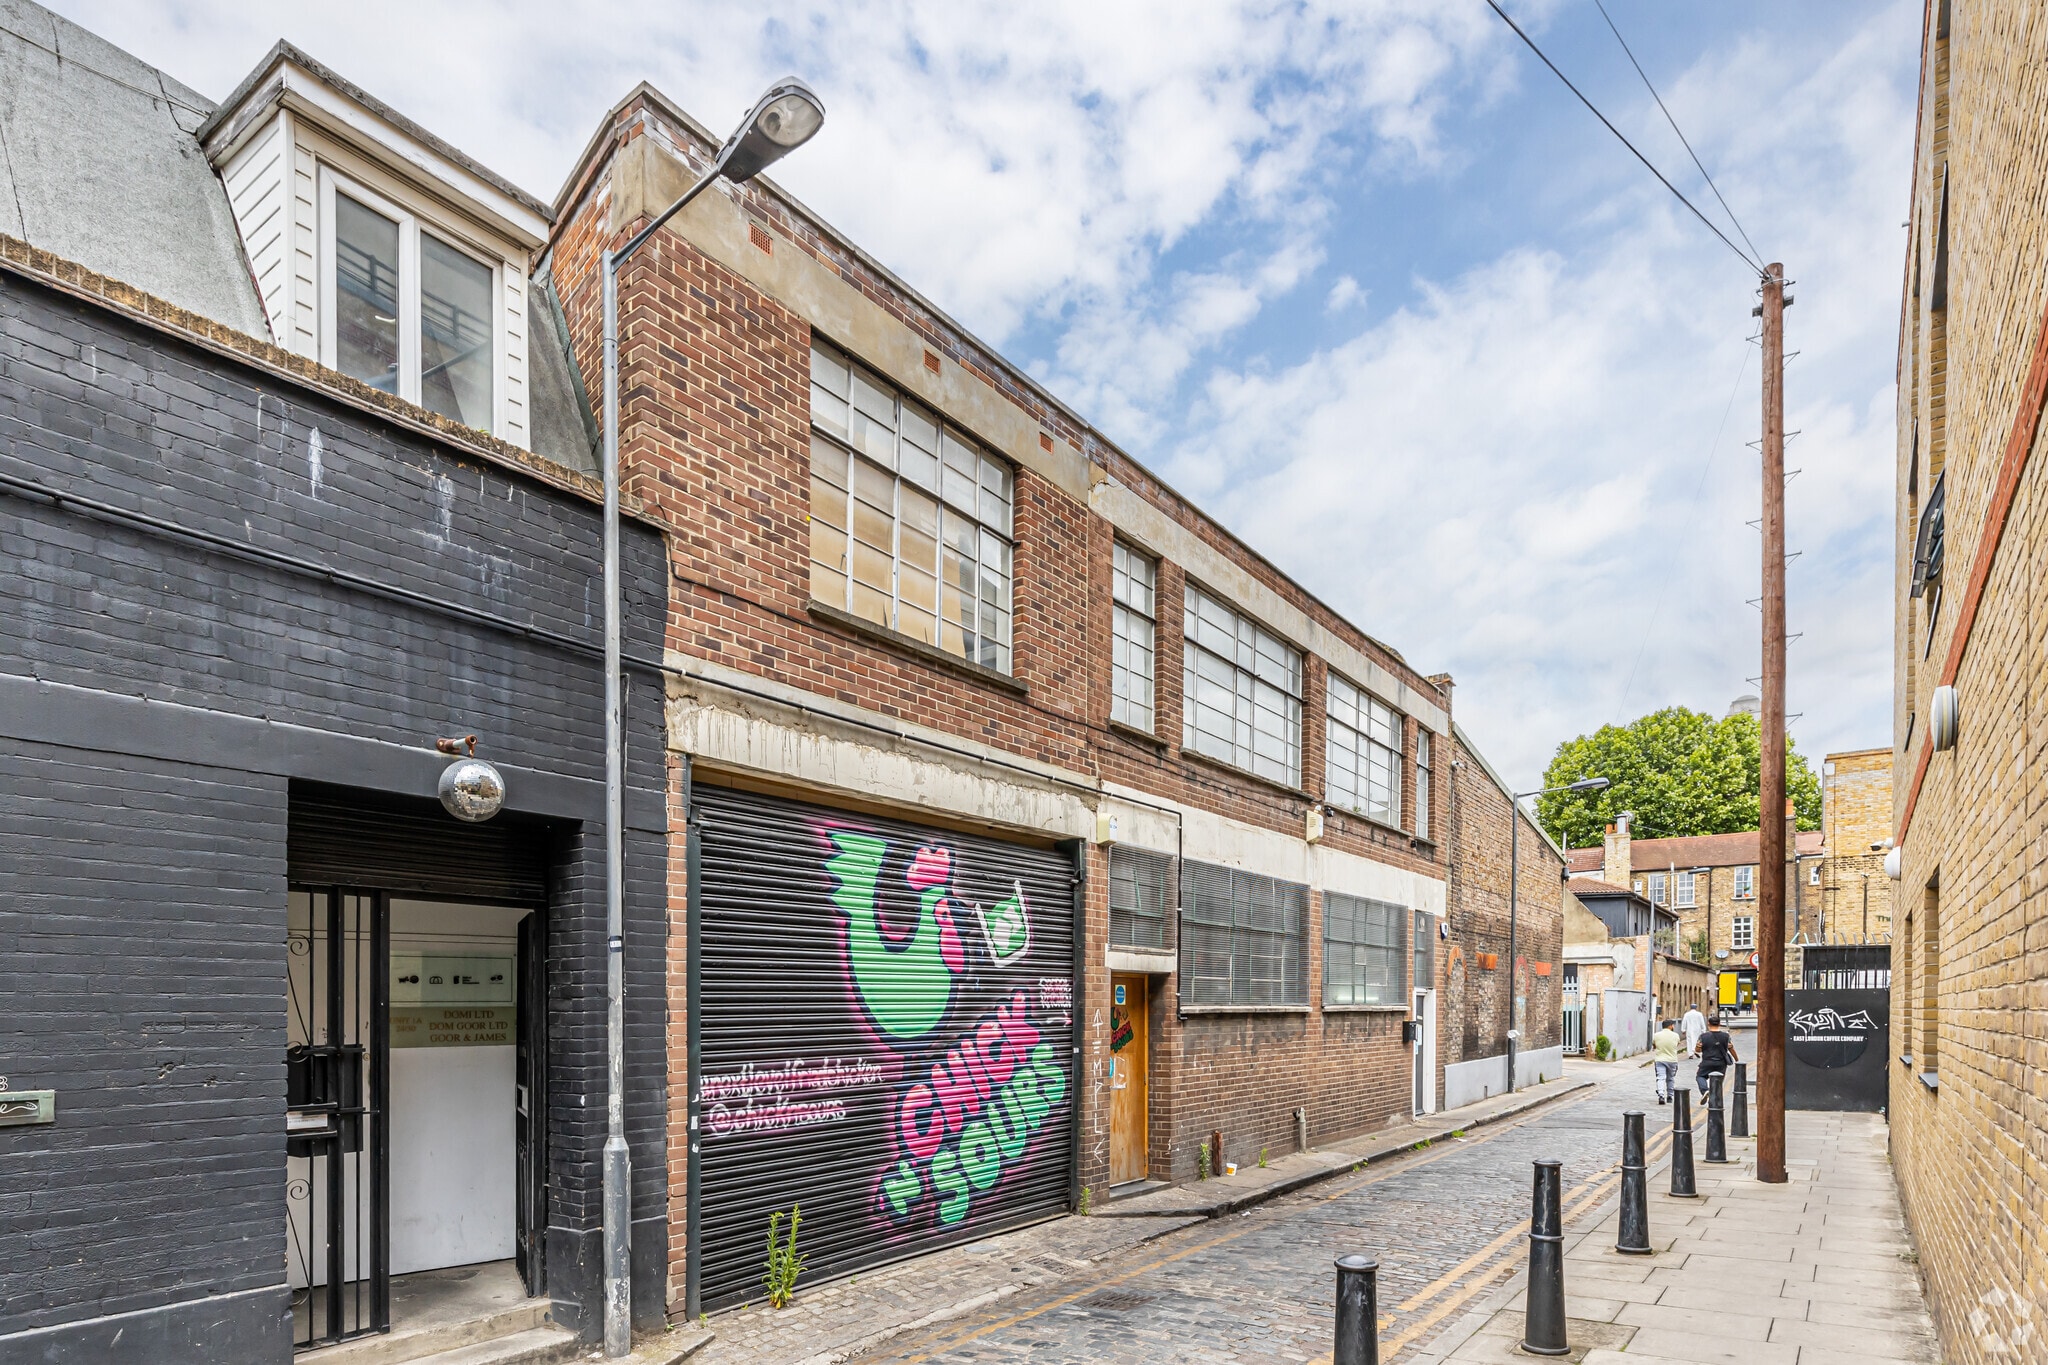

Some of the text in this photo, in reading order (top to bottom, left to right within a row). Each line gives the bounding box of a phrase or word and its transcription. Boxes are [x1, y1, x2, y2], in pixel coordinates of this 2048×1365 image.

[444, 1010, 494, 1019] DOMI LTD
[429, 1021, 508, 1031] DOM GOOR LTD
[430, 1033, 507, 1043] GOOR & JAMES
[901, 991, 1040, 1157] CHICK
[932, 1044, 1066, 1223] SOURS
